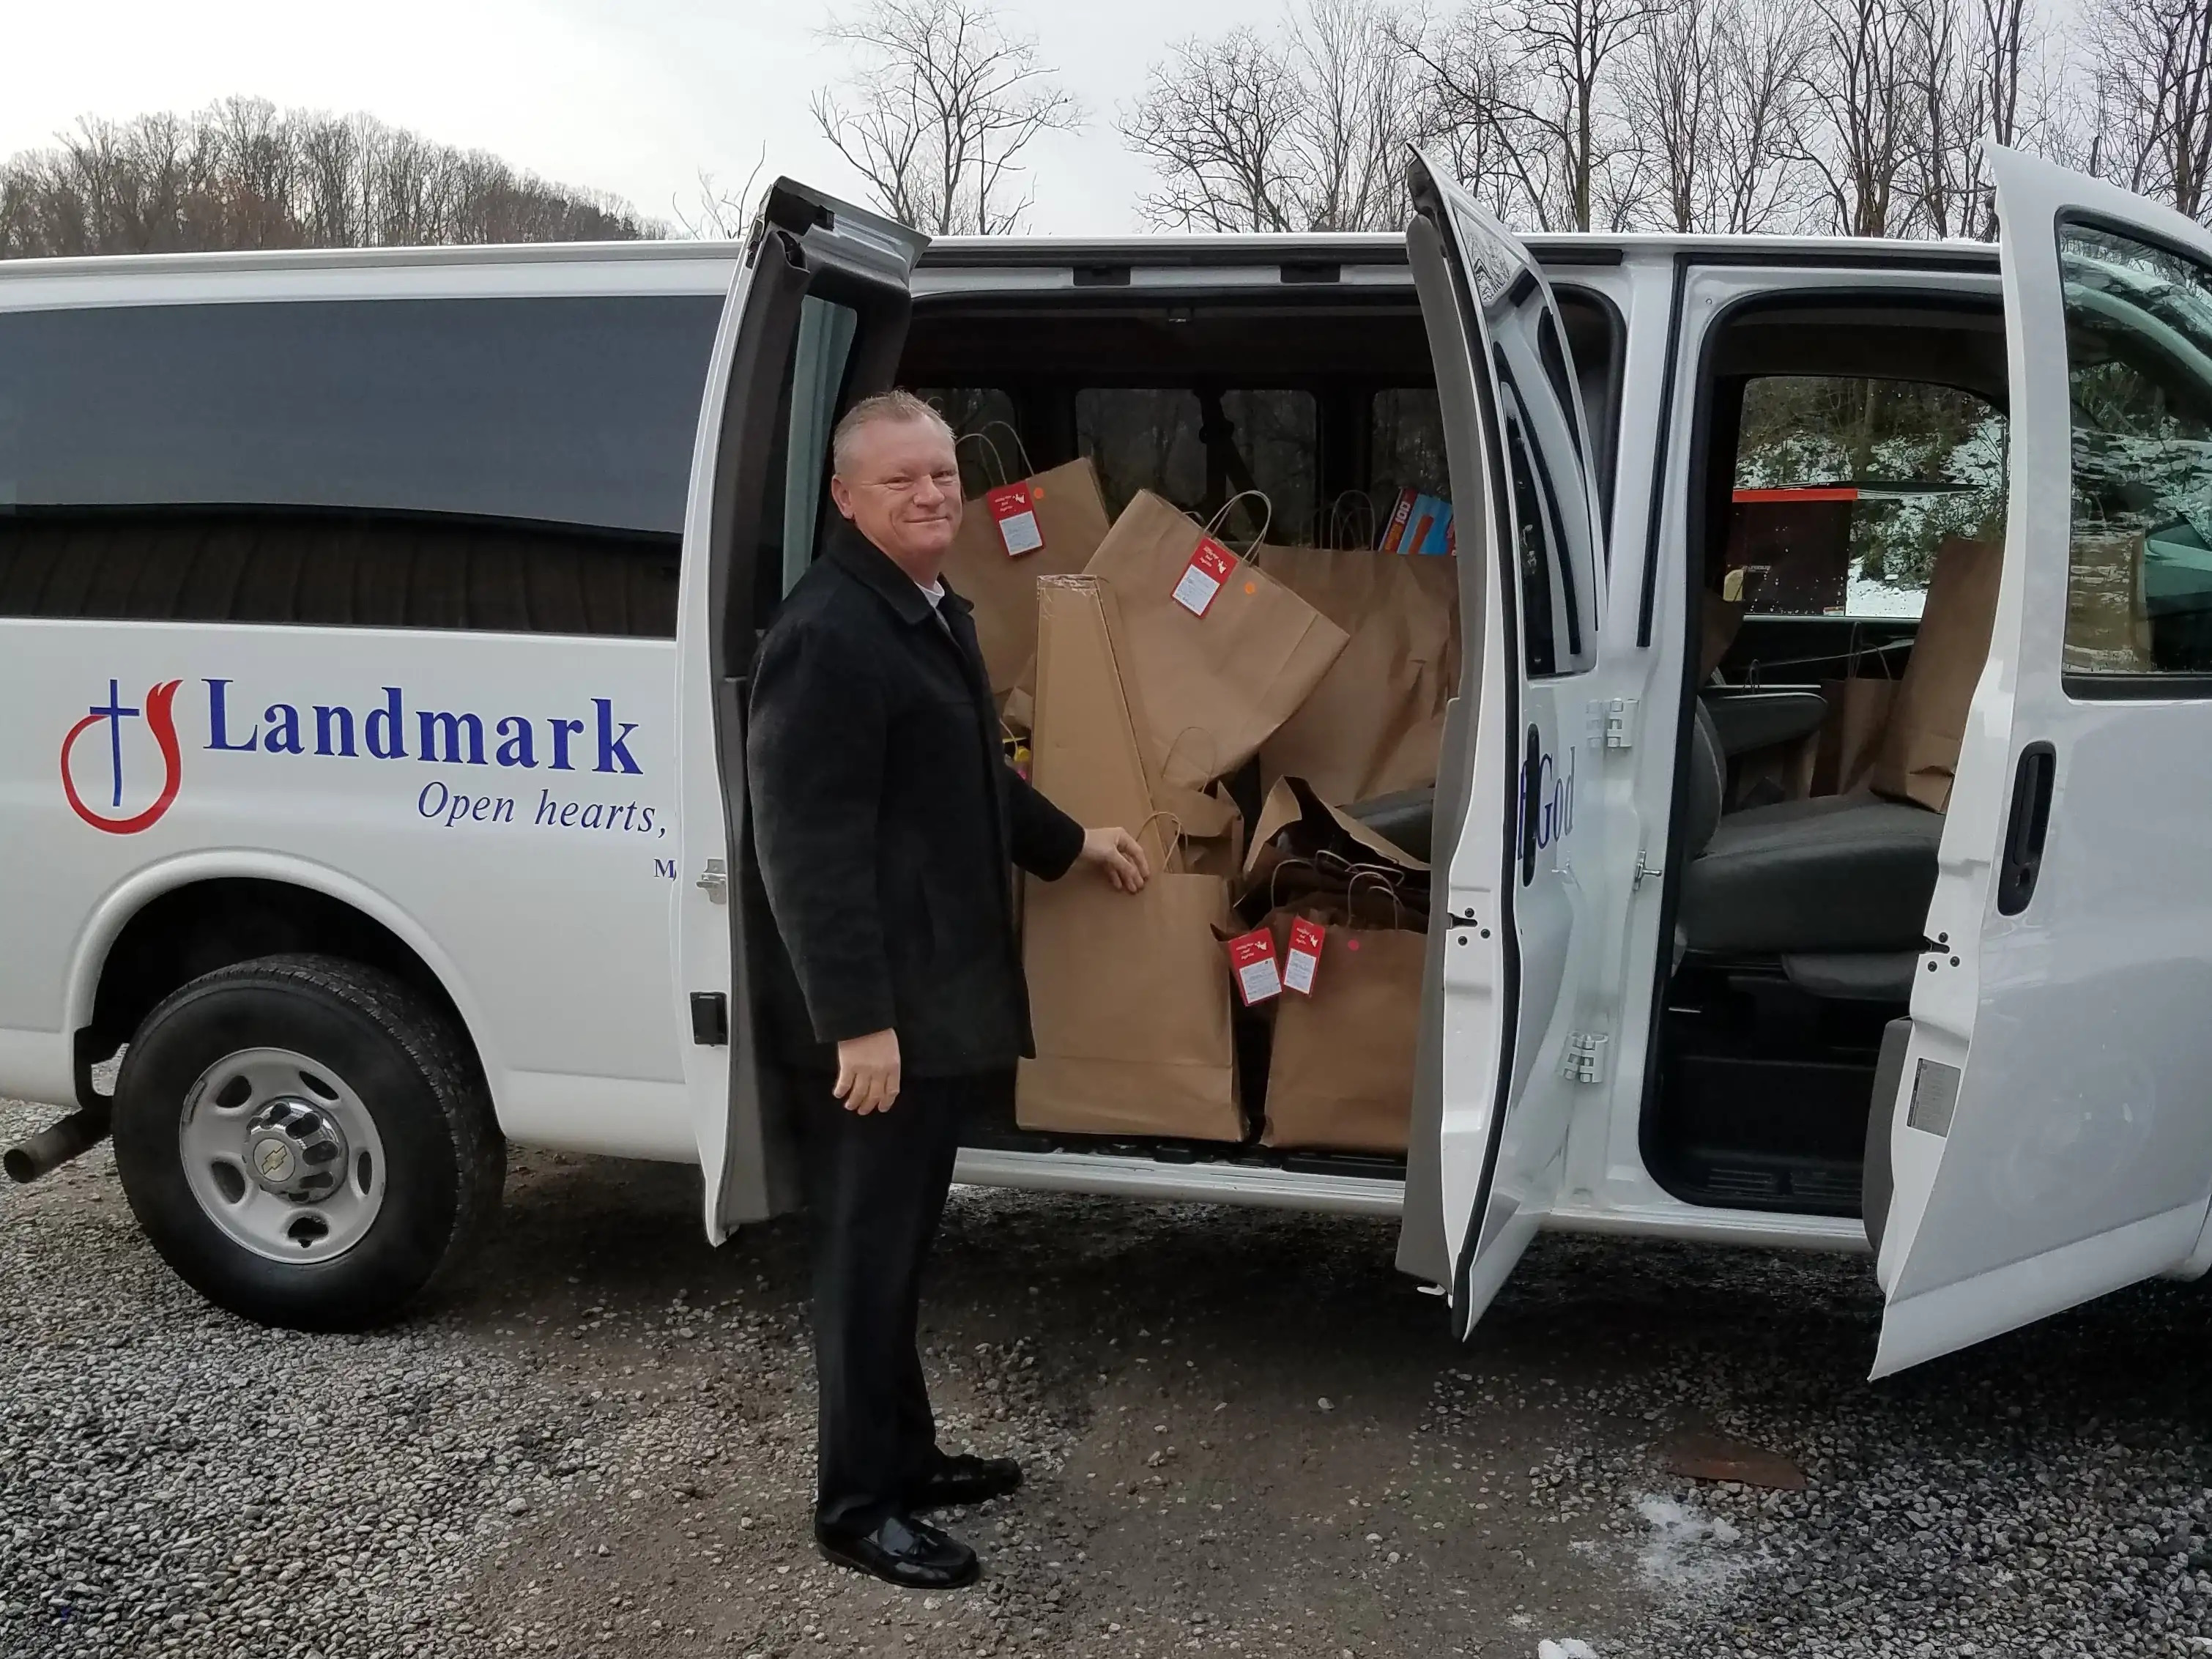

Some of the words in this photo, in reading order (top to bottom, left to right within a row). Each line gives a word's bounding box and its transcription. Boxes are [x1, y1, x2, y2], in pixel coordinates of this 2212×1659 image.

[201, 678, 644, 775] Landmark
[418, 782, 514, 828] Open
[535, 788, 667, 839] hearts,
[1537, 745, 1576, 850] God
